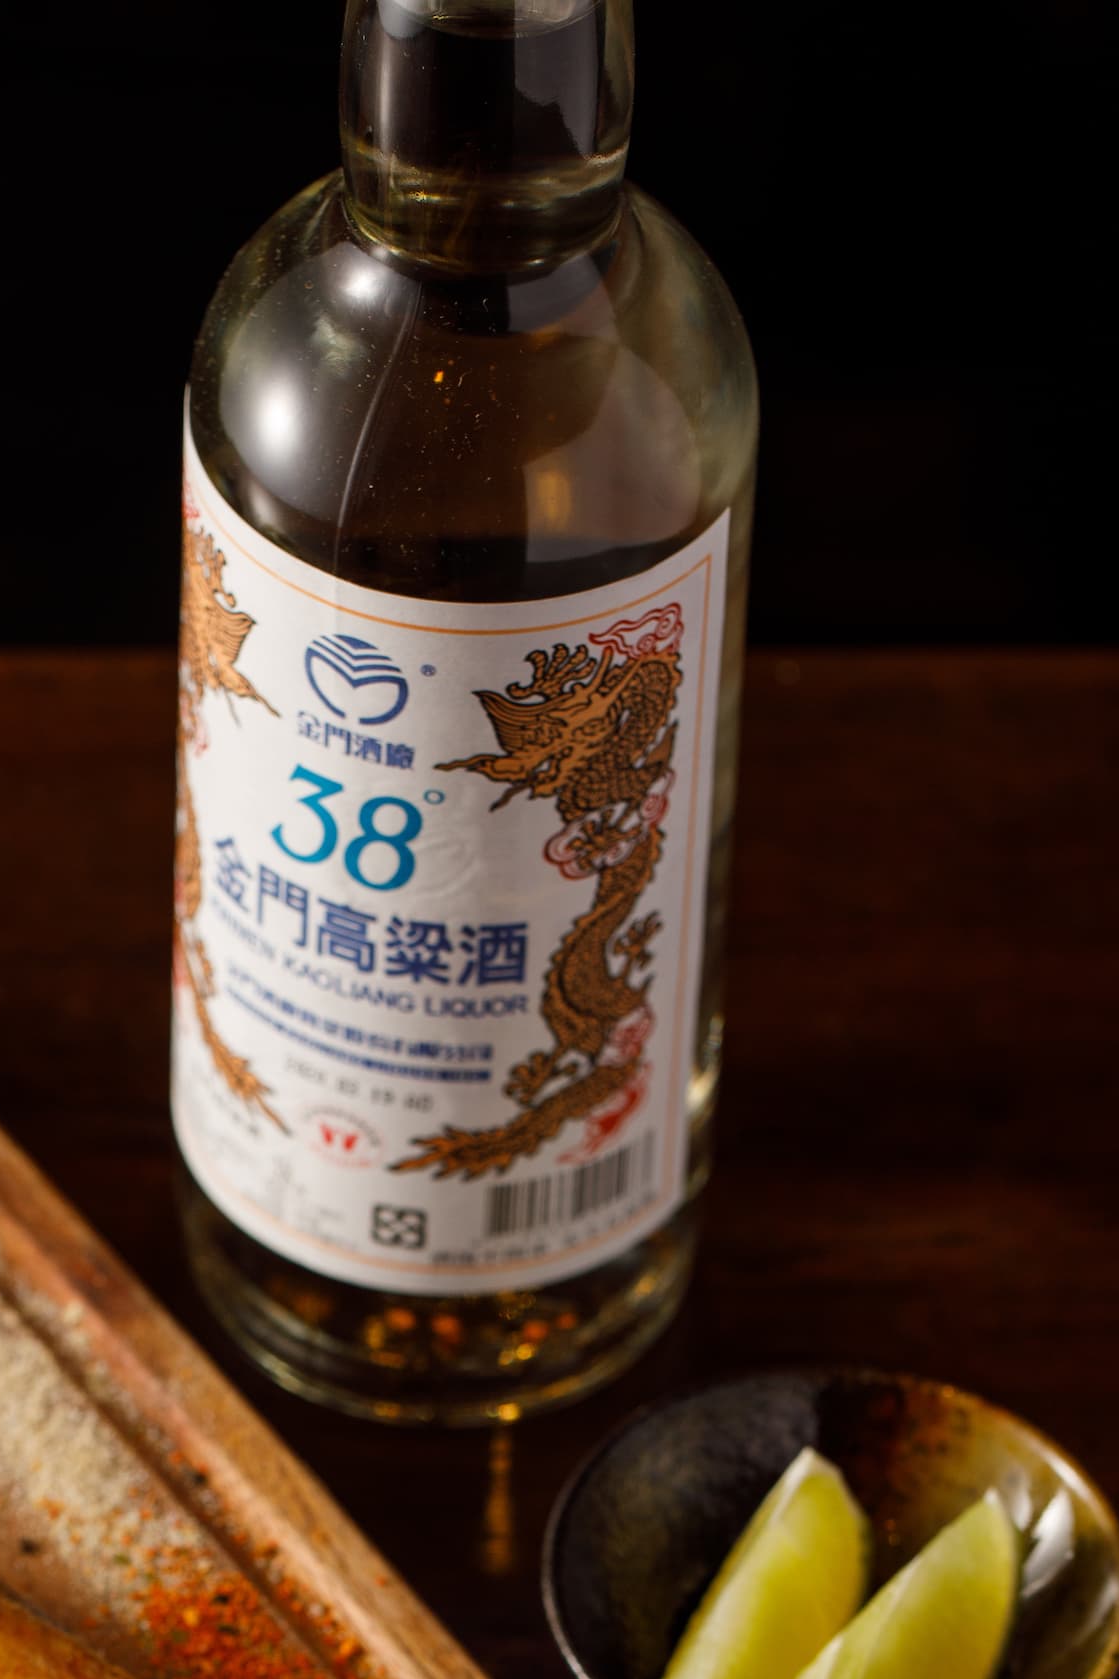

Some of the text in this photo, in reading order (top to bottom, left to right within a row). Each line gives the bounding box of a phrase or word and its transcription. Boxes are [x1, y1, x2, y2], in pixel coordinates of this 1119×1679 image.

[214, 838, 527, 986] 金門高粱酒
[282, 956, 415, 1014] KAOLIANG
[423, 996, 528, 1020] LIQUOR
